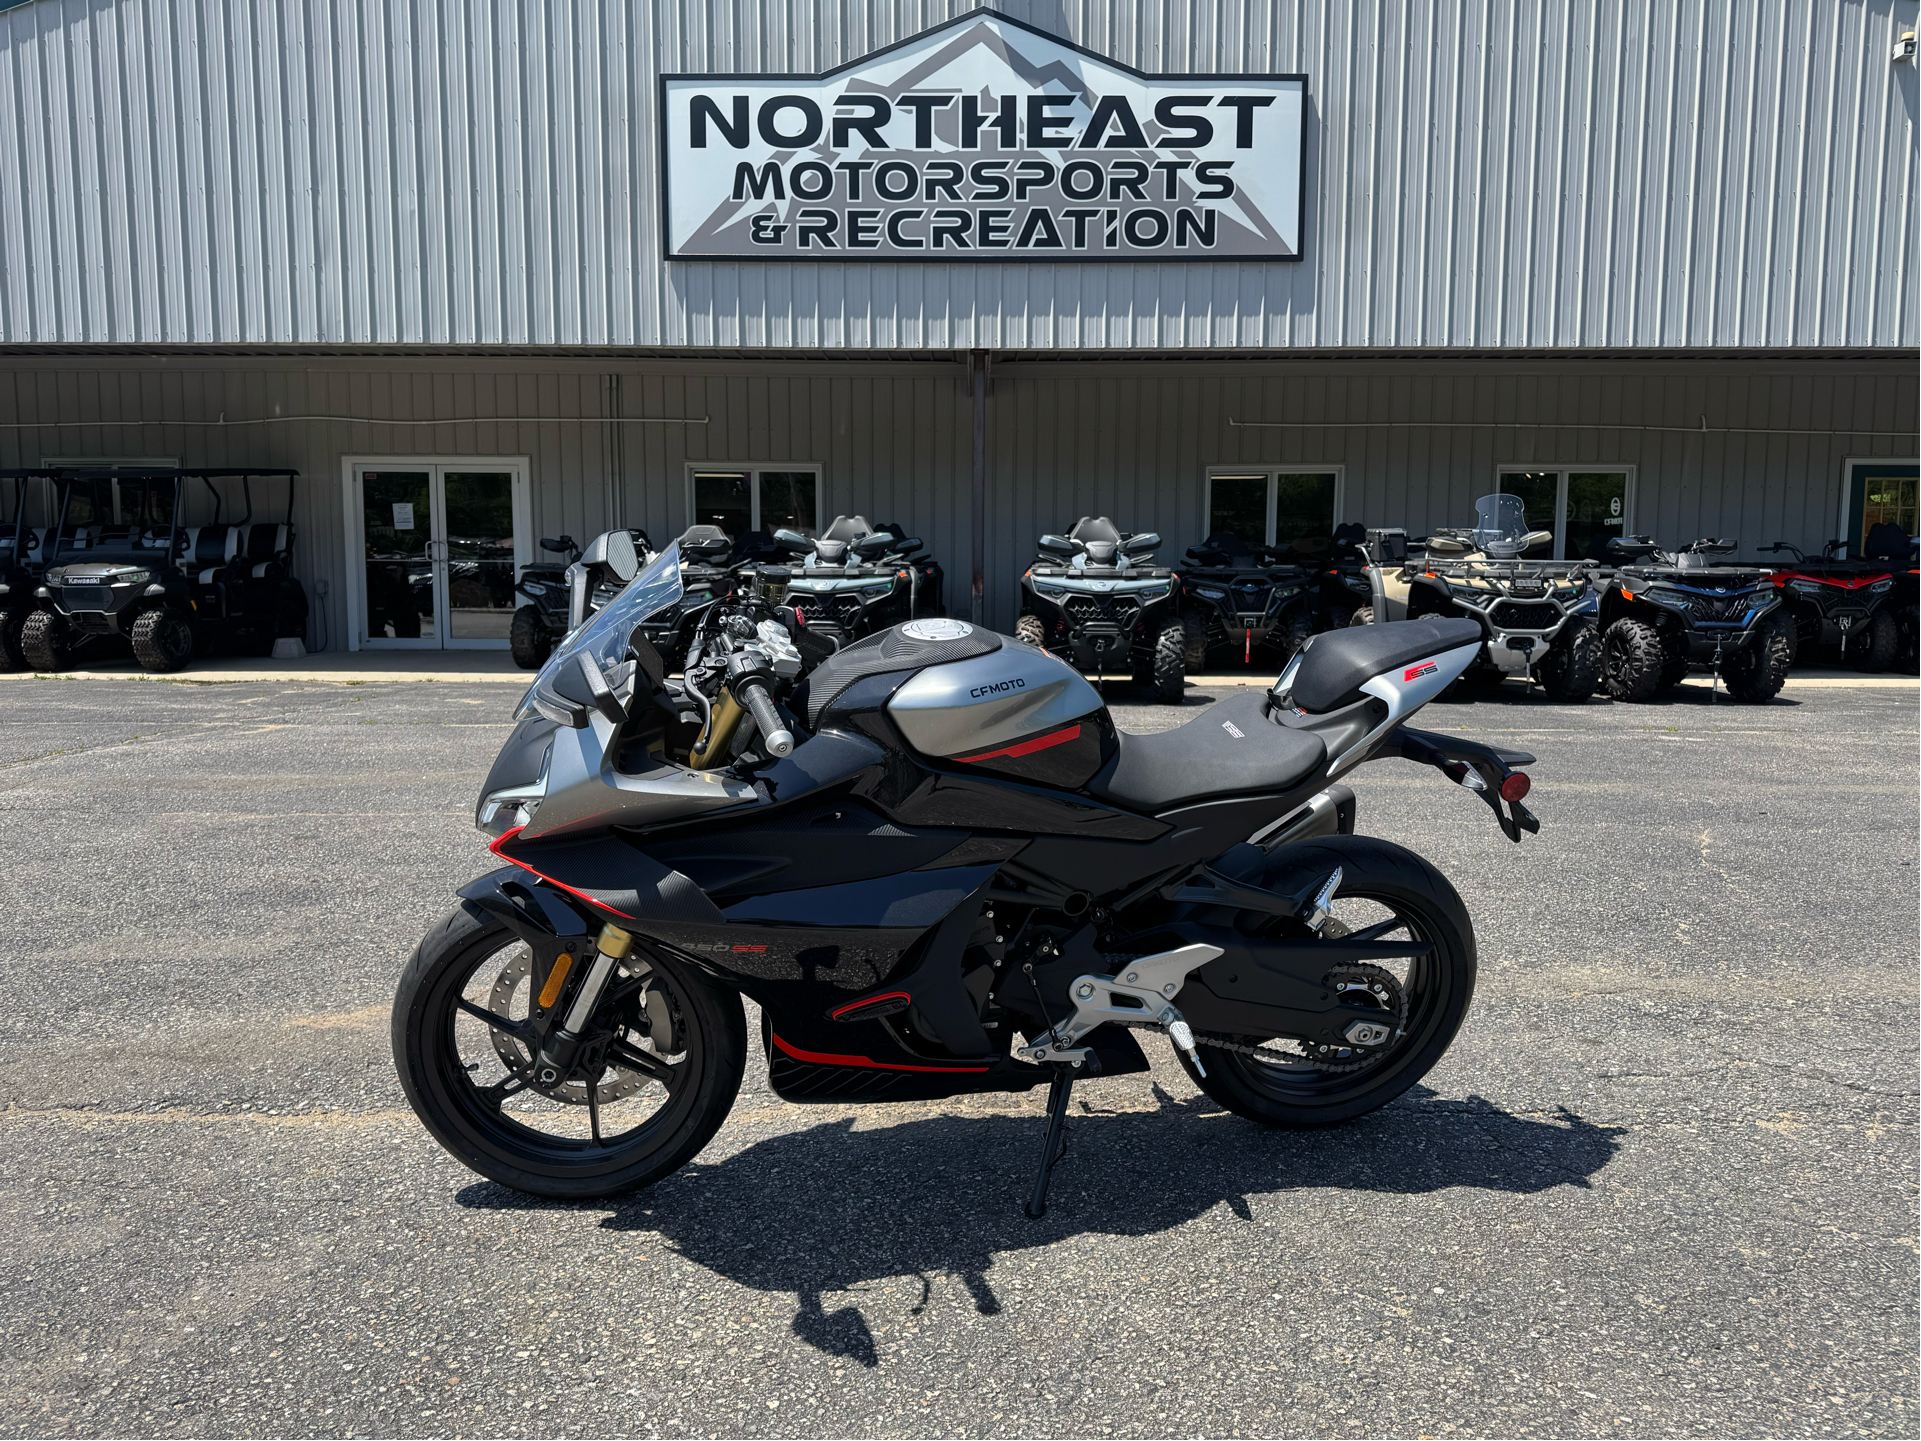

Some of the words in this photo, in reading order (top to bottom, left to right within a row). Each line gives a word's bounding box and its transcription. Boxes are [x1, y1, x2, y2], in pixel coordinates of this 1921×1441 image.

[690, 95, 1277, 149] NORTHEAST
[732, 161, 1235, 200] MOTORSPORTS
[970, 678, 1026, 698] CFMOTO
